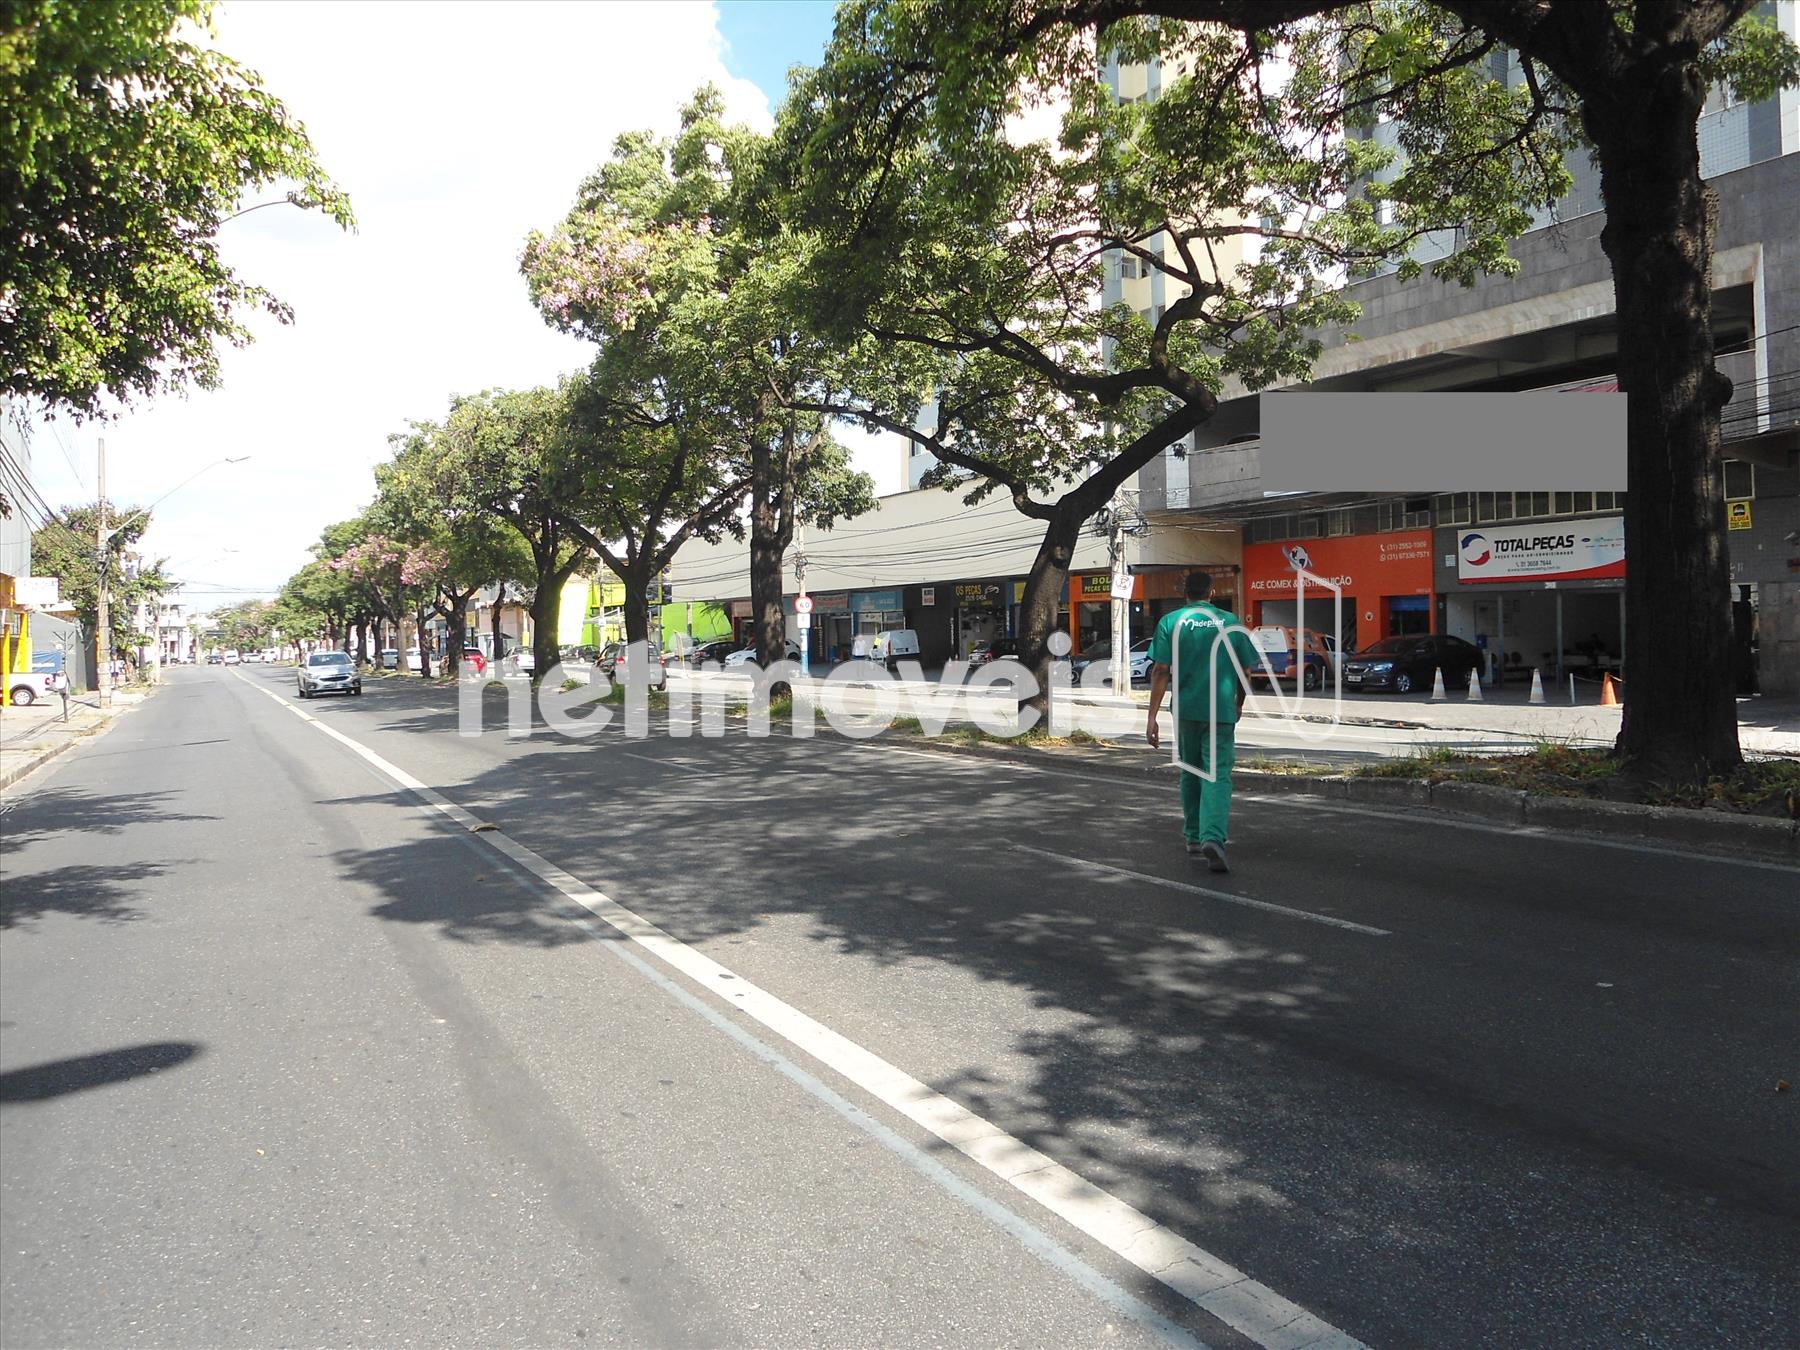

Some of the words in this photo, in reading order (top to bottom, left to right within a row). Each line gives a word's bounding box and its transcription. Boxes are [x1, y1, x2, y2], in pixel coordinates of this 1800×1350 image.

[1494, 534, 1575, 552] TOTALPEÇAS
[1092, 576, 1112, 585] BOL
[1251, 581, 1265, 590] AGE
[1266, 579, 1292, 589] COMEX
[1179, 618, 1224, 630] Madeplan
